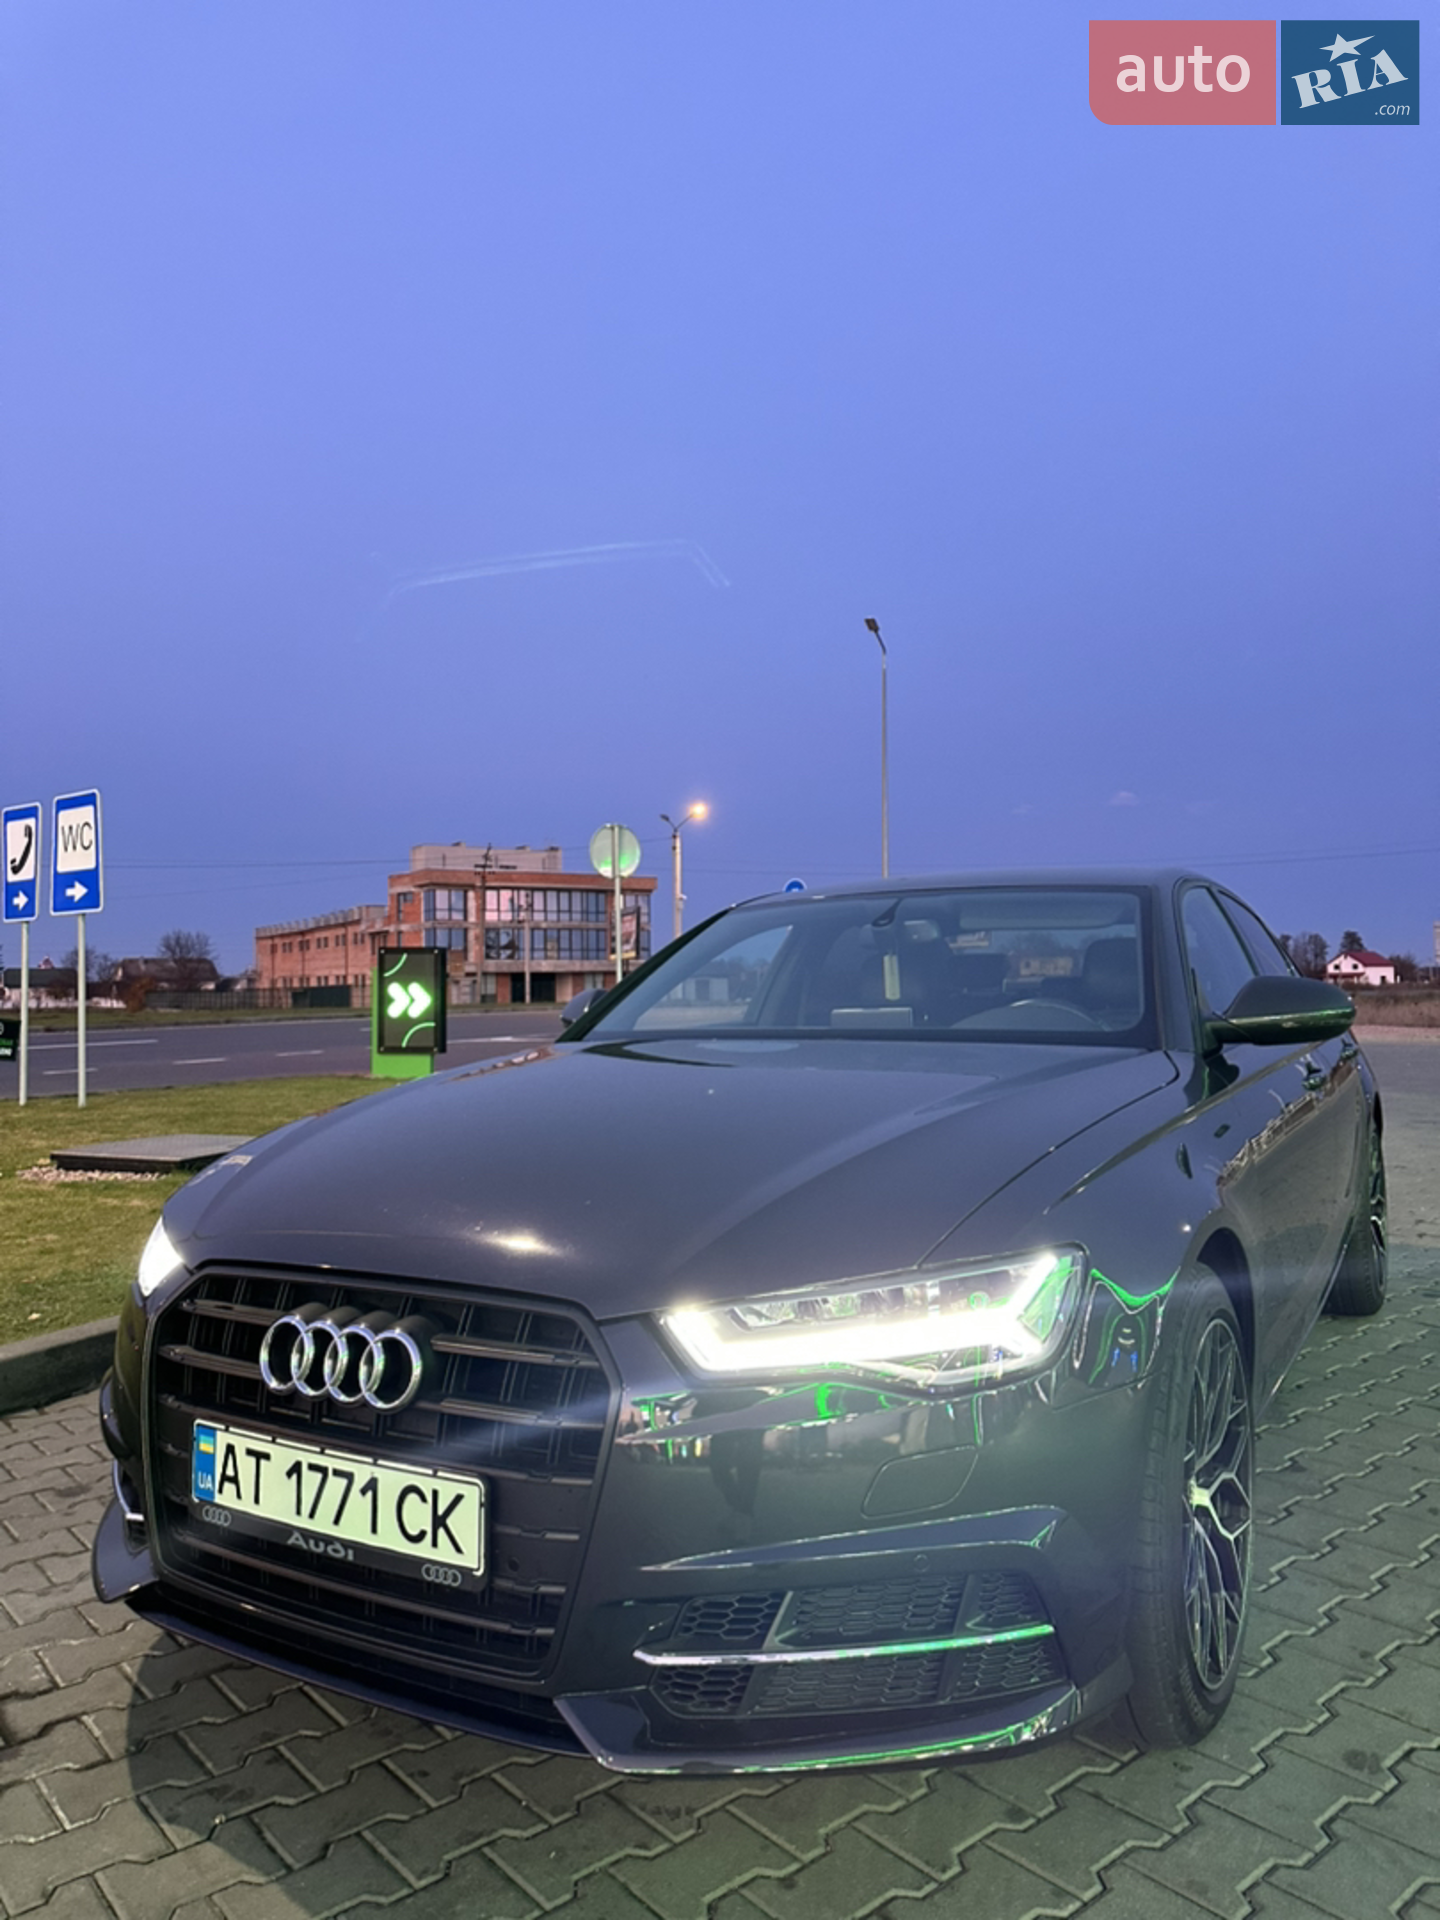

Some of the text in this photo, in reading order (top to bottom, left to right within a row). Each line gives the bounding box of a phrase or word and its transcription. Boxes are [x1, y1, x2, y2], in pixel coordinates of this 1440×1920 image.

[60, 822, 93, 852] WC
[198, 1471, 213, 1491] UA
[218, 1443, 465, 1555] AT 1771 CK
[286, 1531, 354, 1562] Audi
